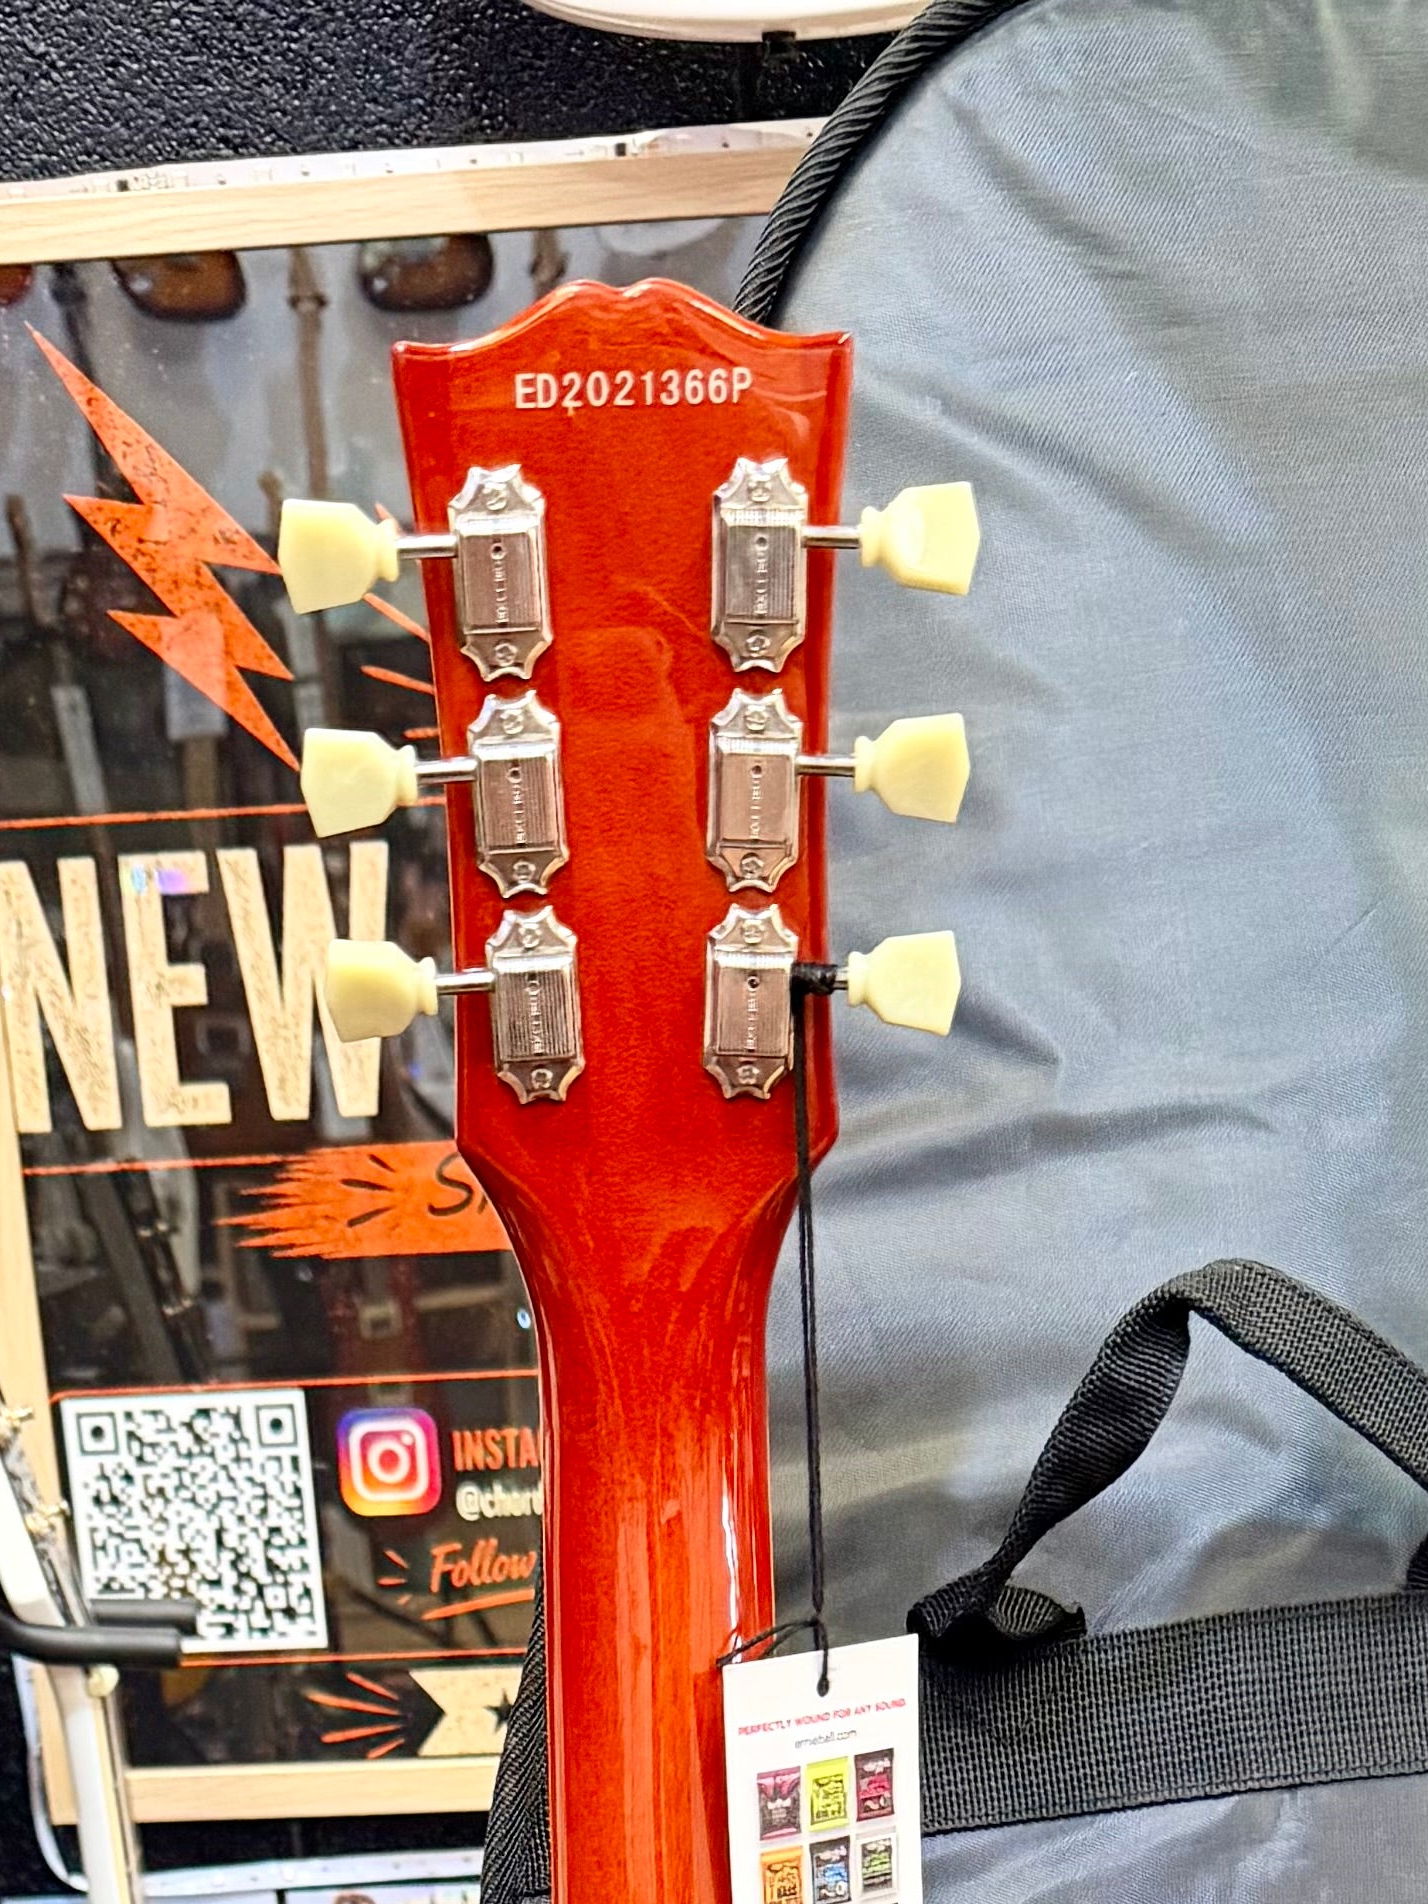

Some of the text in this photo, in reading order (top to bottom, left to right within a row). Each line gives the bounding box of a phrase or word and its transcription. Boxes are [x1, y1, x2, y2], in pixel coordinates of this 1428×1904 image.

[515, 367, 752, 409] ED2021366P
[452, 1426, 541, 1472] INSTA
[429, 1537, 537, 1594] Follow
